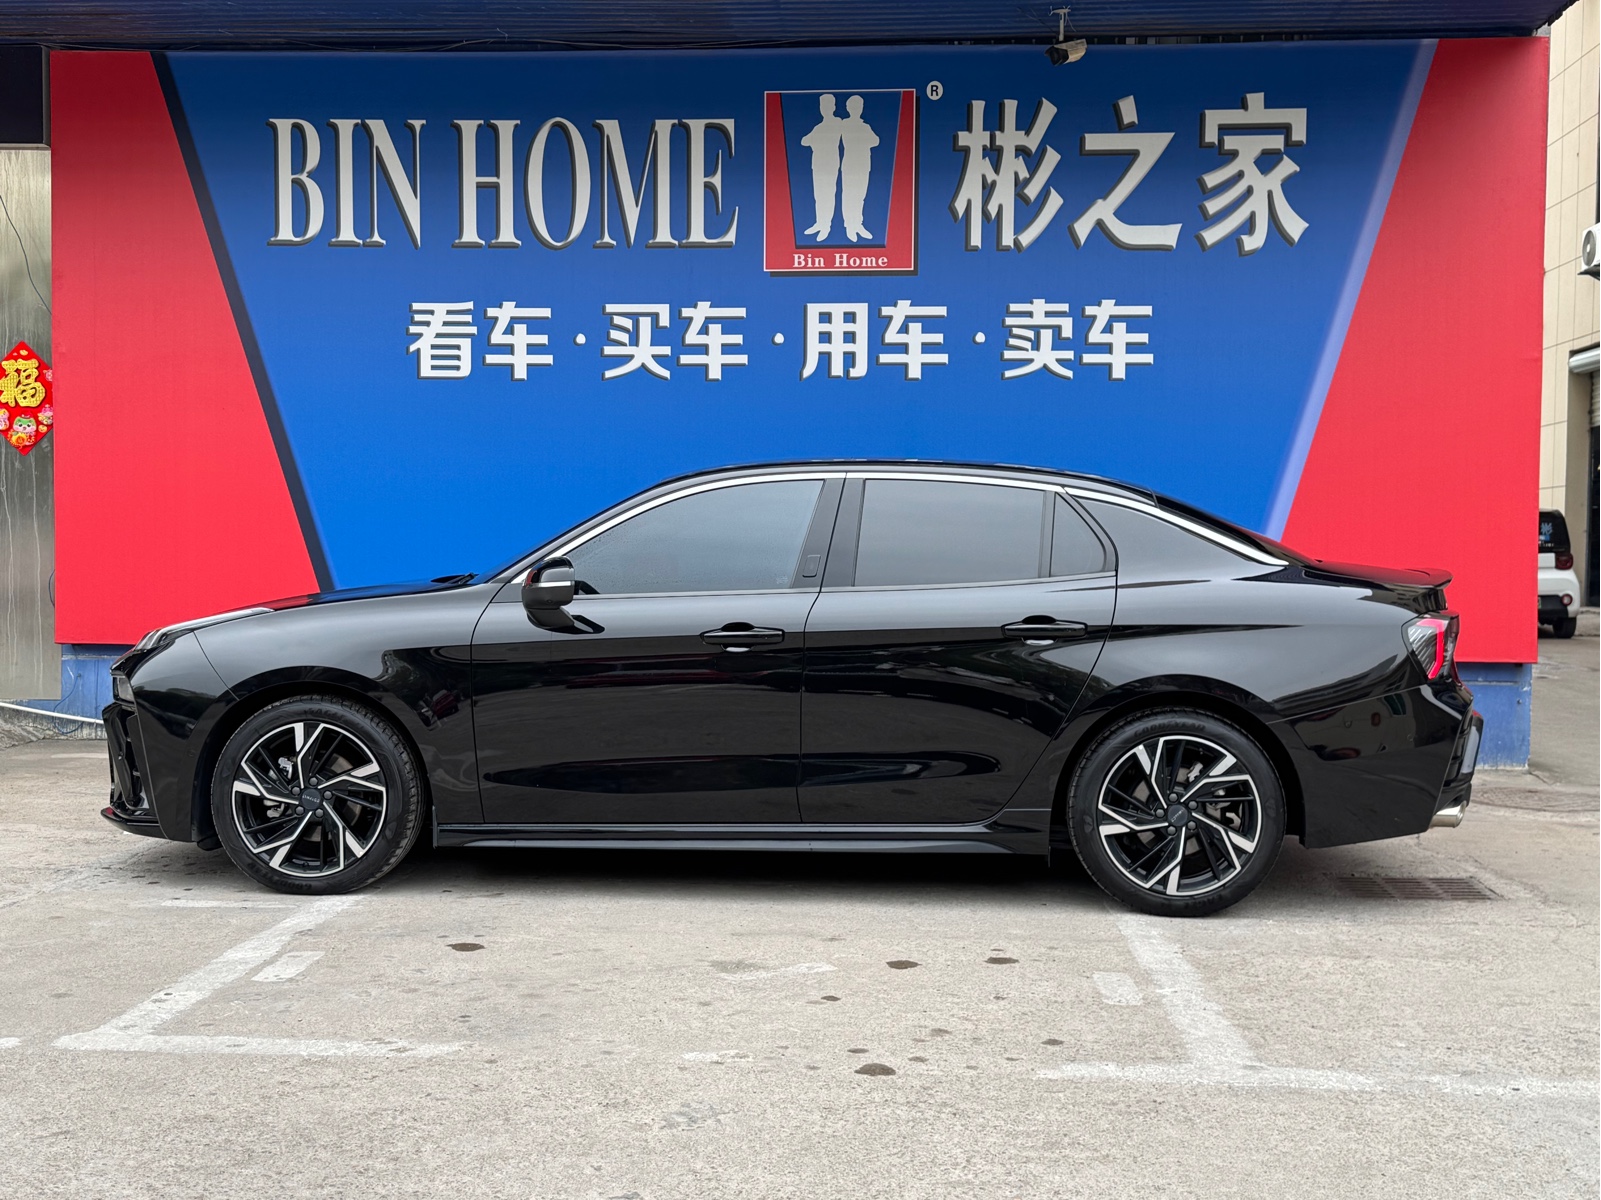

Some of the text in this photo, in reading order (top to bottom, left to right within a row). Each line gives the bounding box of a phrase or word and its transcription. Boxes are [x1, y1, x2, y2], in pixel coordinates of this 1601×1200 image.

[266, 116, 739, 251] BIN HOME
[949, 92, 1309, 256] 彬之家
[792, 253, 888, 267] Bin Home
[0, 358, 46, 408] 福
